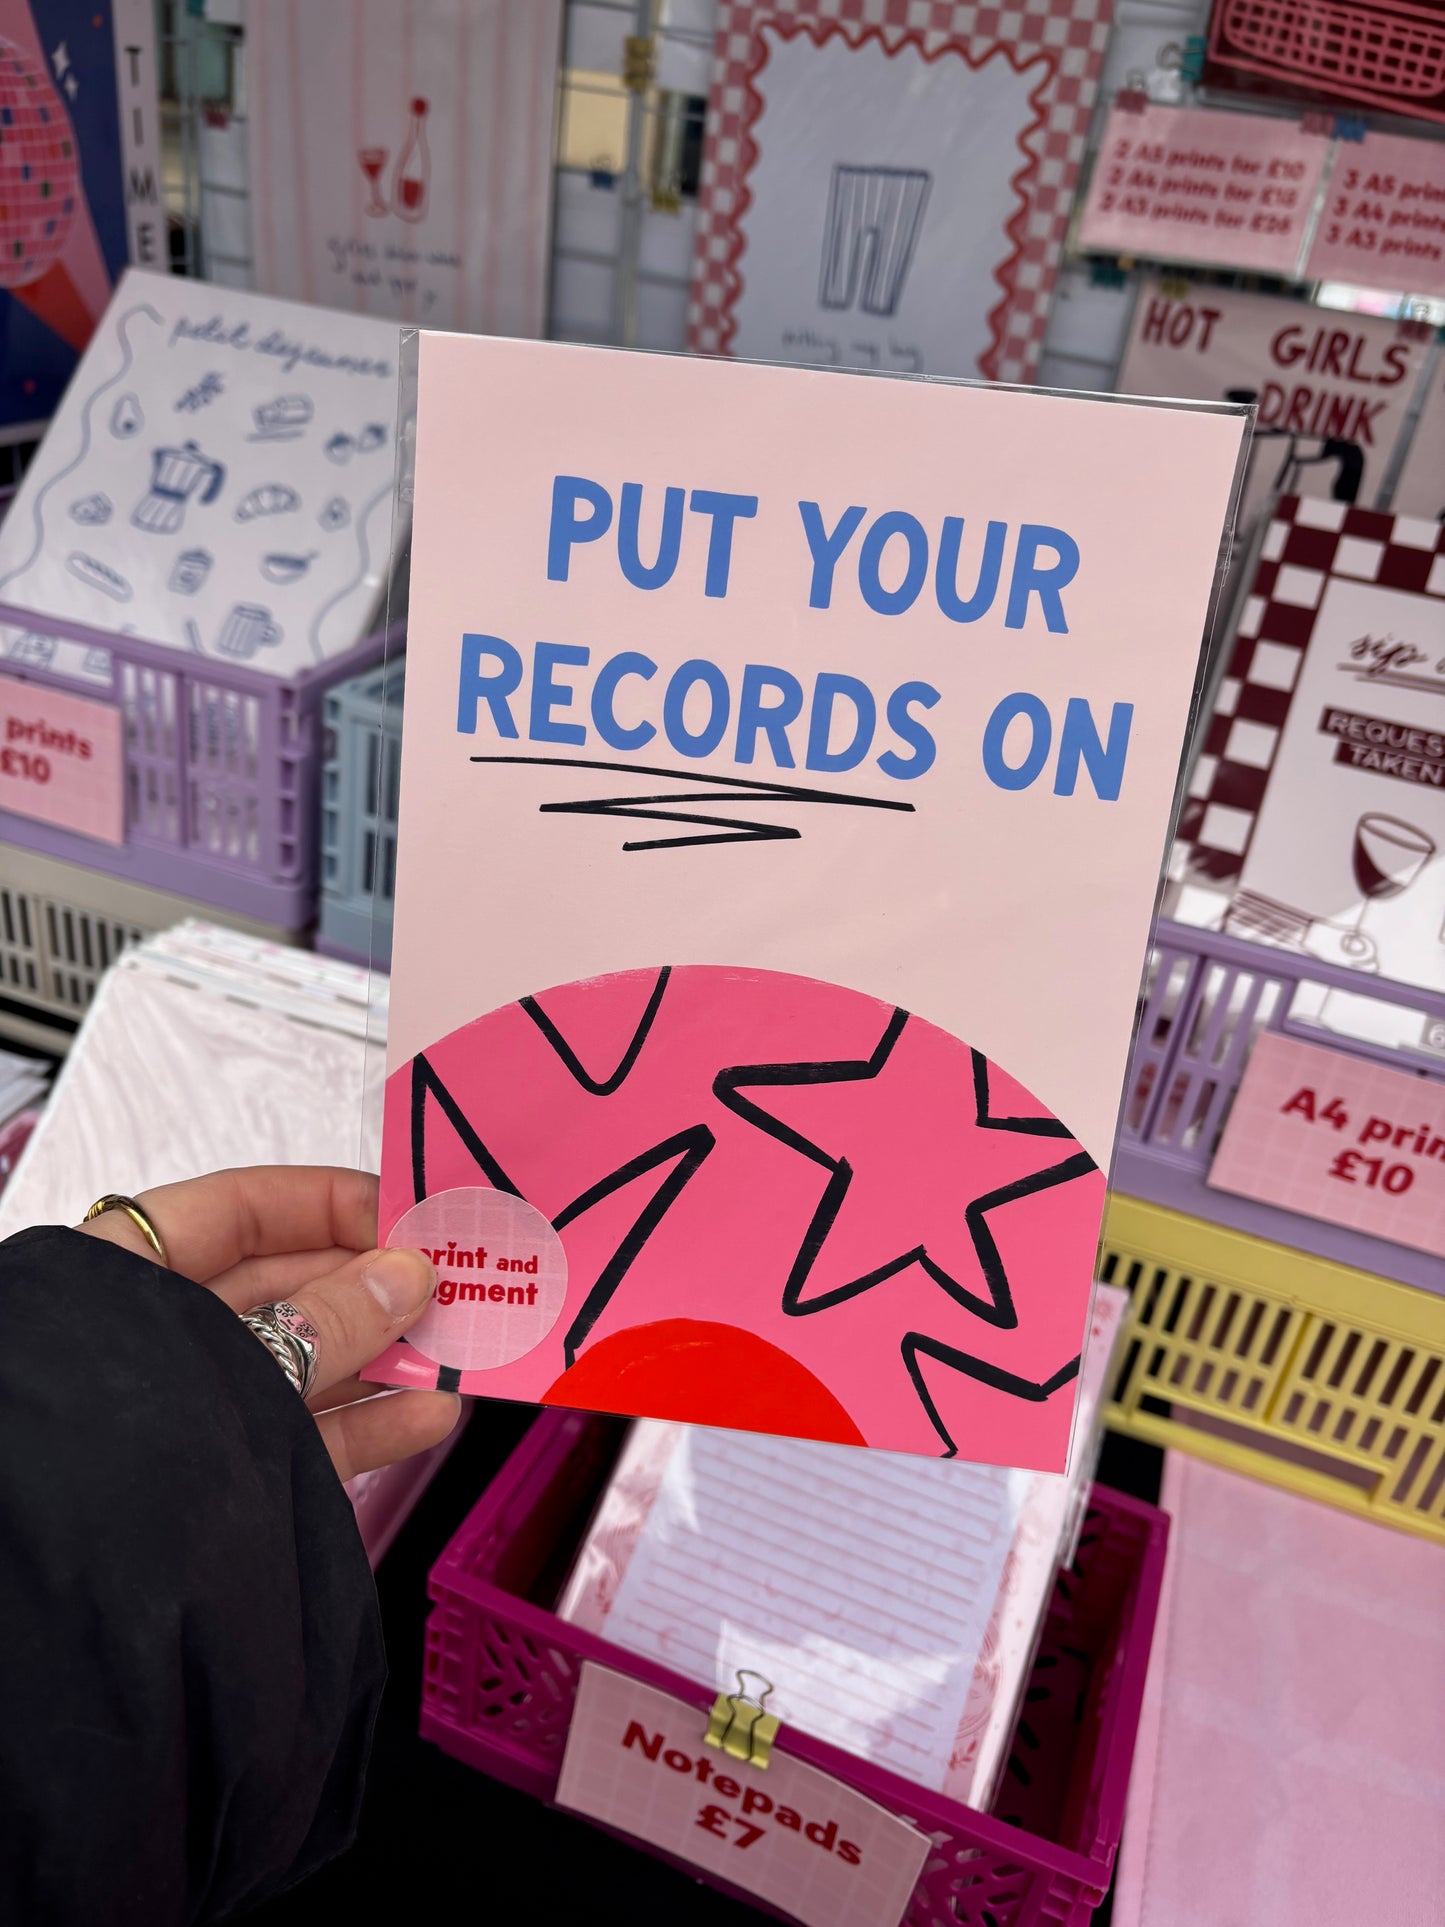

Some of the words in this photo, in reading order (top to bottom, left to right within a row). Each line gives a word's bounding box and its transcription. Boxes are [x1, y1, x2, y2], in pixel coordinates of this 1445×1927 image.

[1166, 150, 1226, 172] prints
[1231, 154, 1260, 174] for
[1343, 168, 1359, 191] 3
[1159, 175, 1219, 199] prints
[1224, 180, 1254, 203] for
[1333, 195, 1348, 218] 3
[1353, 200, 1384, 221] A4
[1150, 203, 1209, 226] prints
[1214, 209, 1244, 229] for
[1326, 223, 1340, 246] 3
[1346, 228, 1376, 250] A3
[1380, 237, 1441, 261] prints
[1143, 298, 1223, 353] HOT
[1270, 325, 1411, 389] GIRLS
[1256, 381, 1388, 447] DRINK
[547, 475, 758, 598] PUT
[798, 500, 1080, 634] YOUR
[457, 633, 941, 780] RECORDS
[982, 692, 1134, 801] ON
[6, 716, 92, 760] prints
[0, 747, 50, 785] £10
[1352, 746, 1443, 785] TAKEN
[1280, 1086, 1349, 1132] A4
[1328, 1149, 1415, 1196] £10
[497, 1255, 538, 1274] and
[433, 1279, 538, 1306] gment
[621, 1720, 862, 1867] Notepads
[695, 1804, 767, 1850] £7
